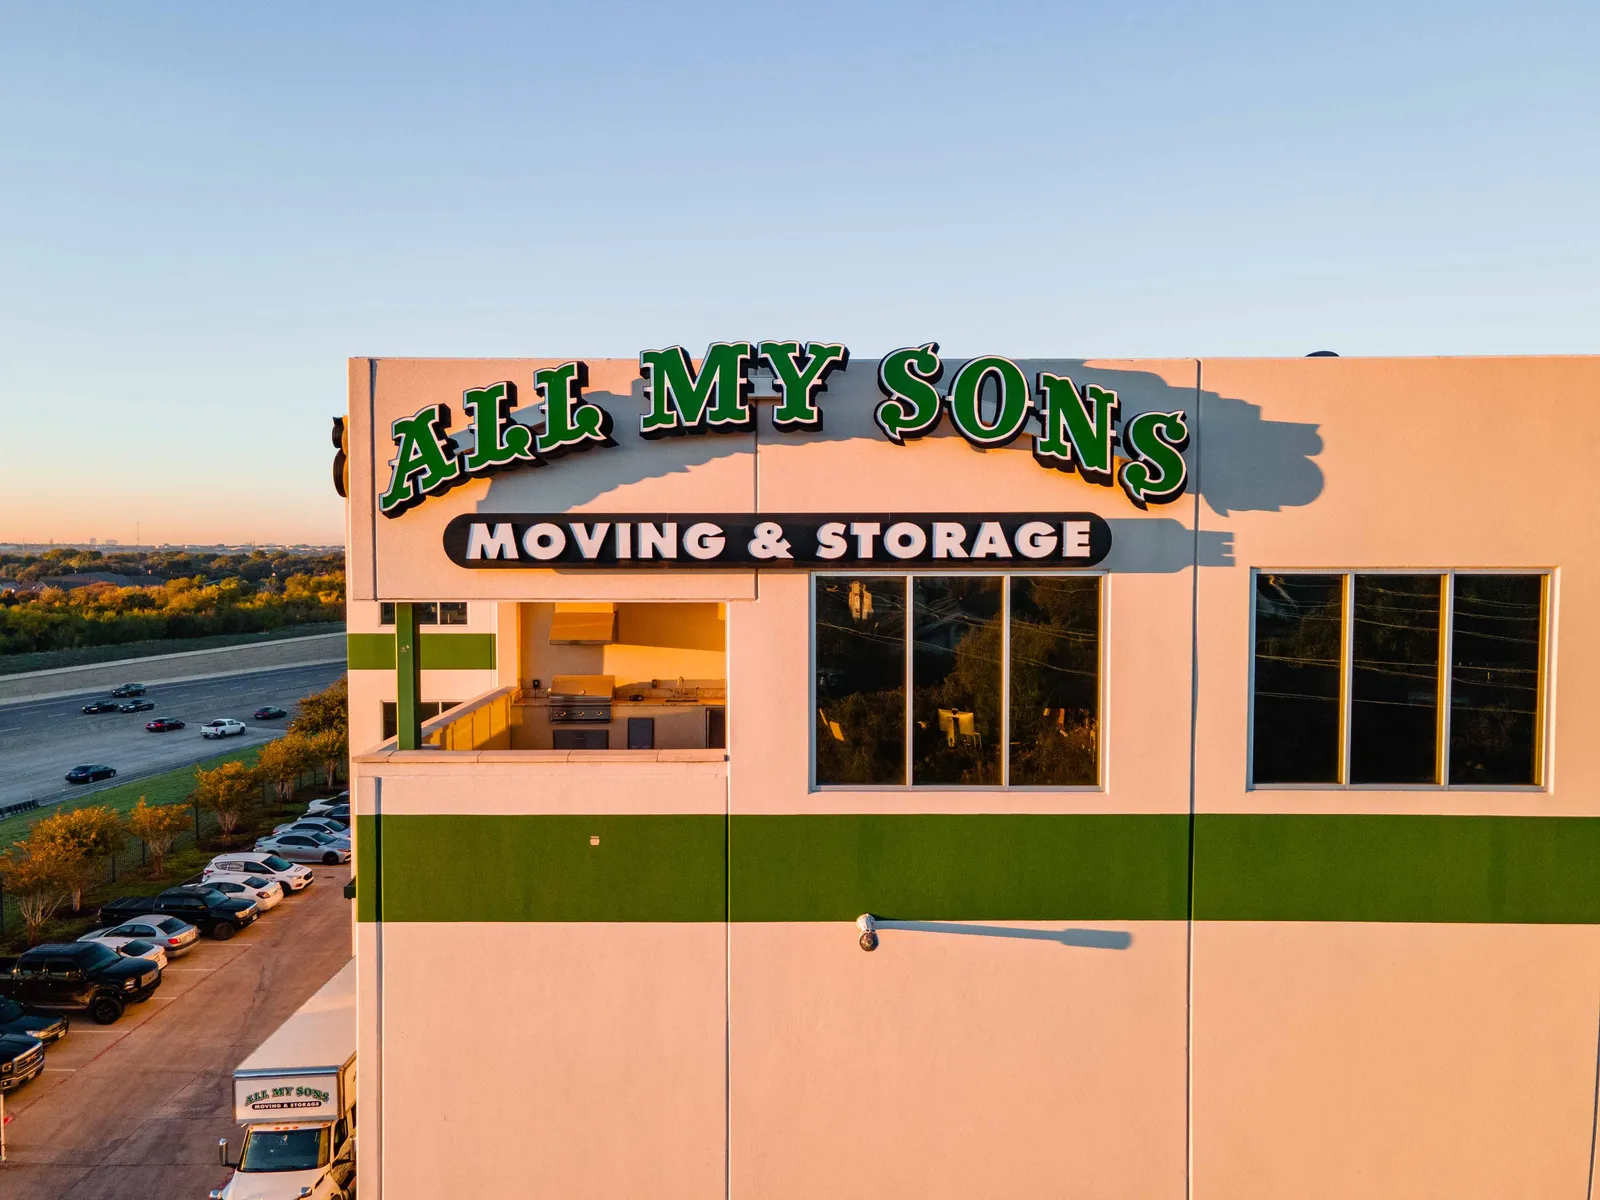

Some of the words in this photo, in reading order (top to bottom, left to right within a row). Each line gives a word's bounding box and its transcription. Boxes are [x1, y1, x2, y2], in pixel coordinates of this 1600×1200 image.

[379, 361, 614, 518] ALL
[640, 340, 849, 438] MY
[874, 342, 1190, 509] SONS
[465, 522, 726, 560] MOVING
[747, 521, 794, 559] &
[815, 521, 1091, 559] STORAGE
[245, 1089, 269, 1106] ALL
[272, 1086, 294, 1098] MY
[296, 1086, 329, 1103] SONS
